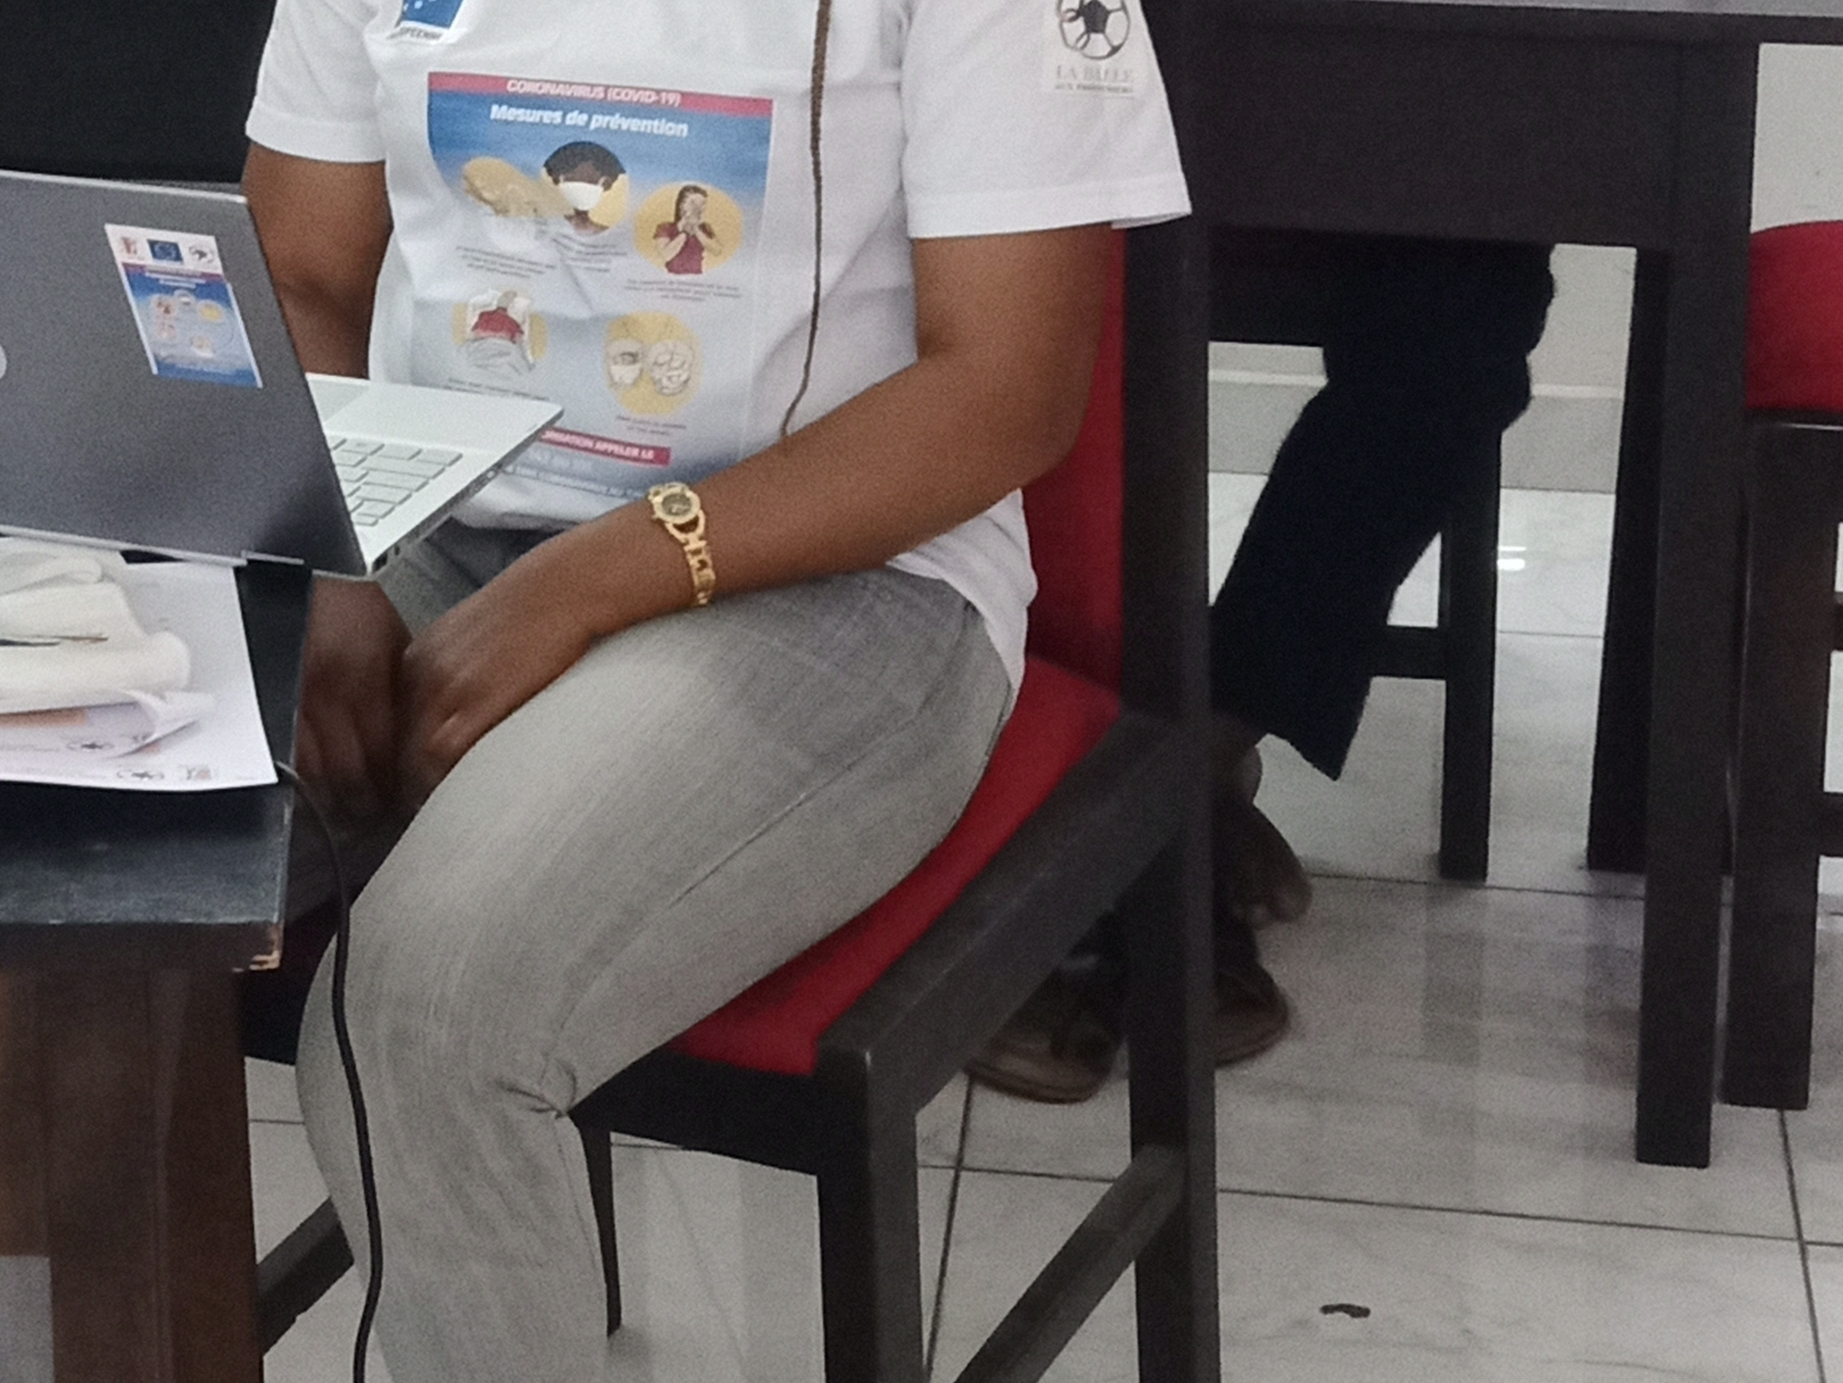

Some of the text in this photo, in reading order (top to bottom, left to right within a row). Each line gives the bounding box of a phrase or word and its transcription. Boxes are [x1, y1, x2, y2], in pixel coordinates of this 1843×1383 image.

[507, 79, 682, 108] CORONAVIRUS (COVID-19)
[490, 103, 690, 138] Mesures de prévention
